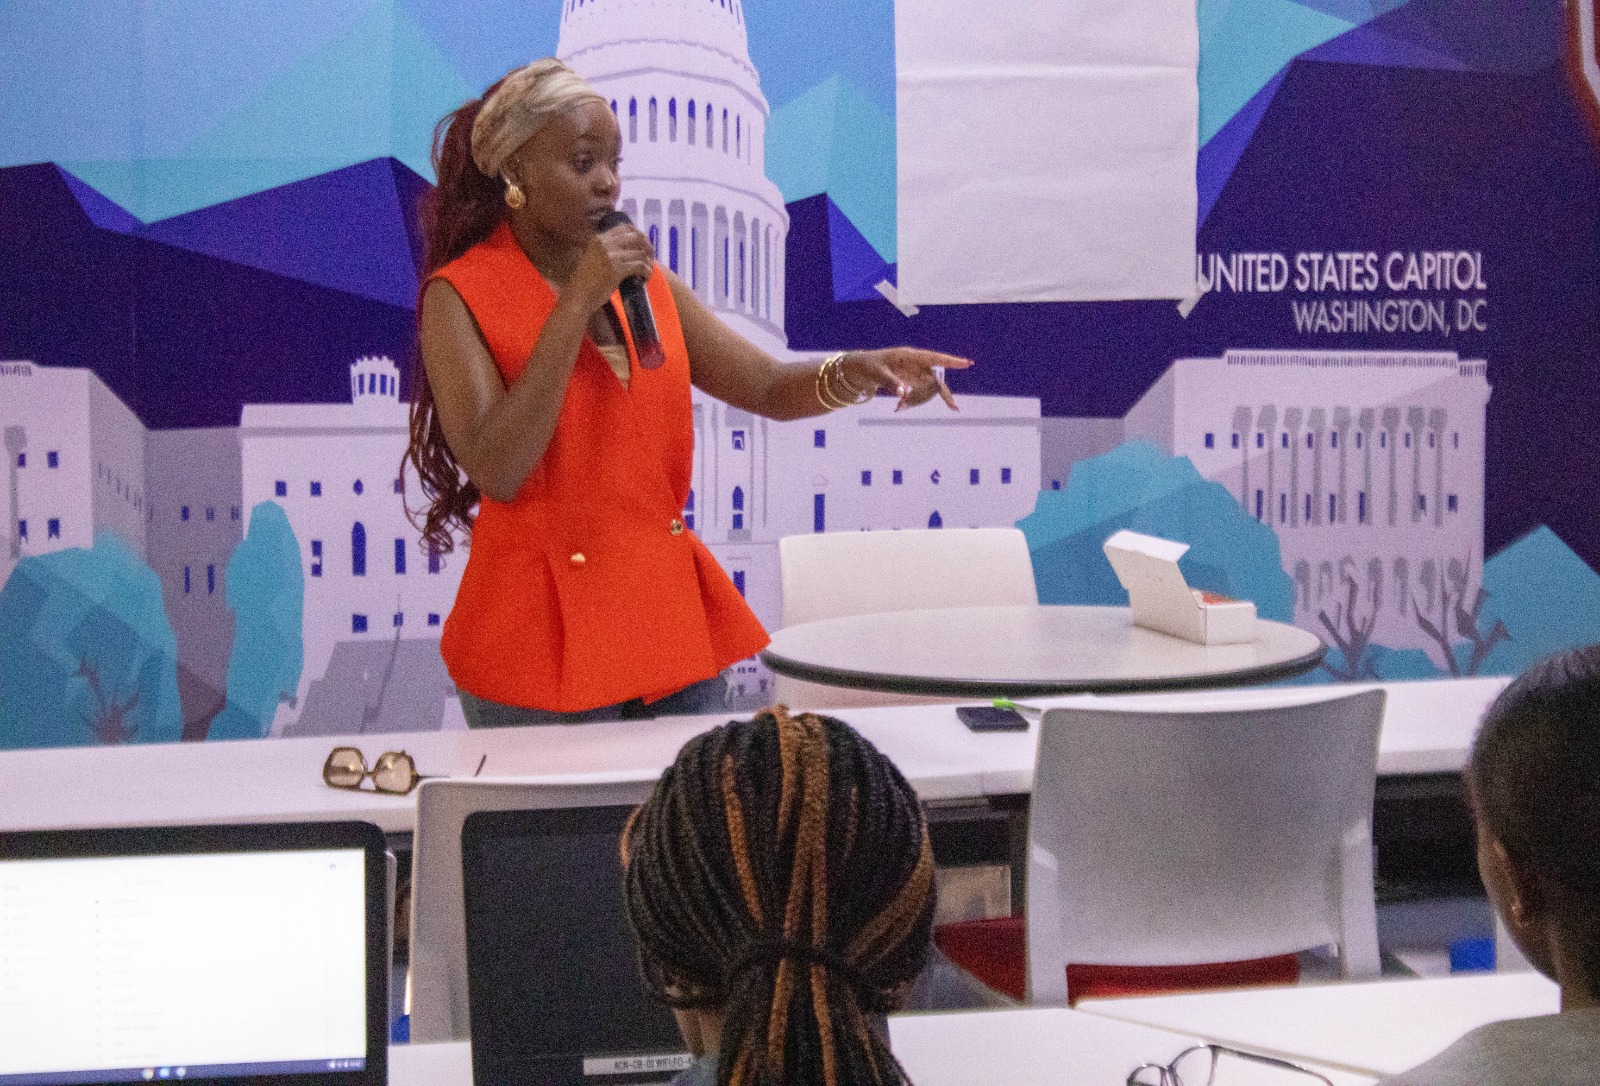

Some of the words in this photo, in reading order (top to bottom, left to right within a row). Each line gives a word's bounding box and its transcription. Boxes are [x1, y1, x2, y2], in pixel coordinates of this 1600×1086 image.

[1198, 253, 1289, 292] UNITED
[1294, 252, 1379, 292] STATES
[1385, 251, 1487, 291] CAPITOL
[1292, 300, 1450, 337] WASHINGTON,
[1458, 300, 1487, 332] DC
